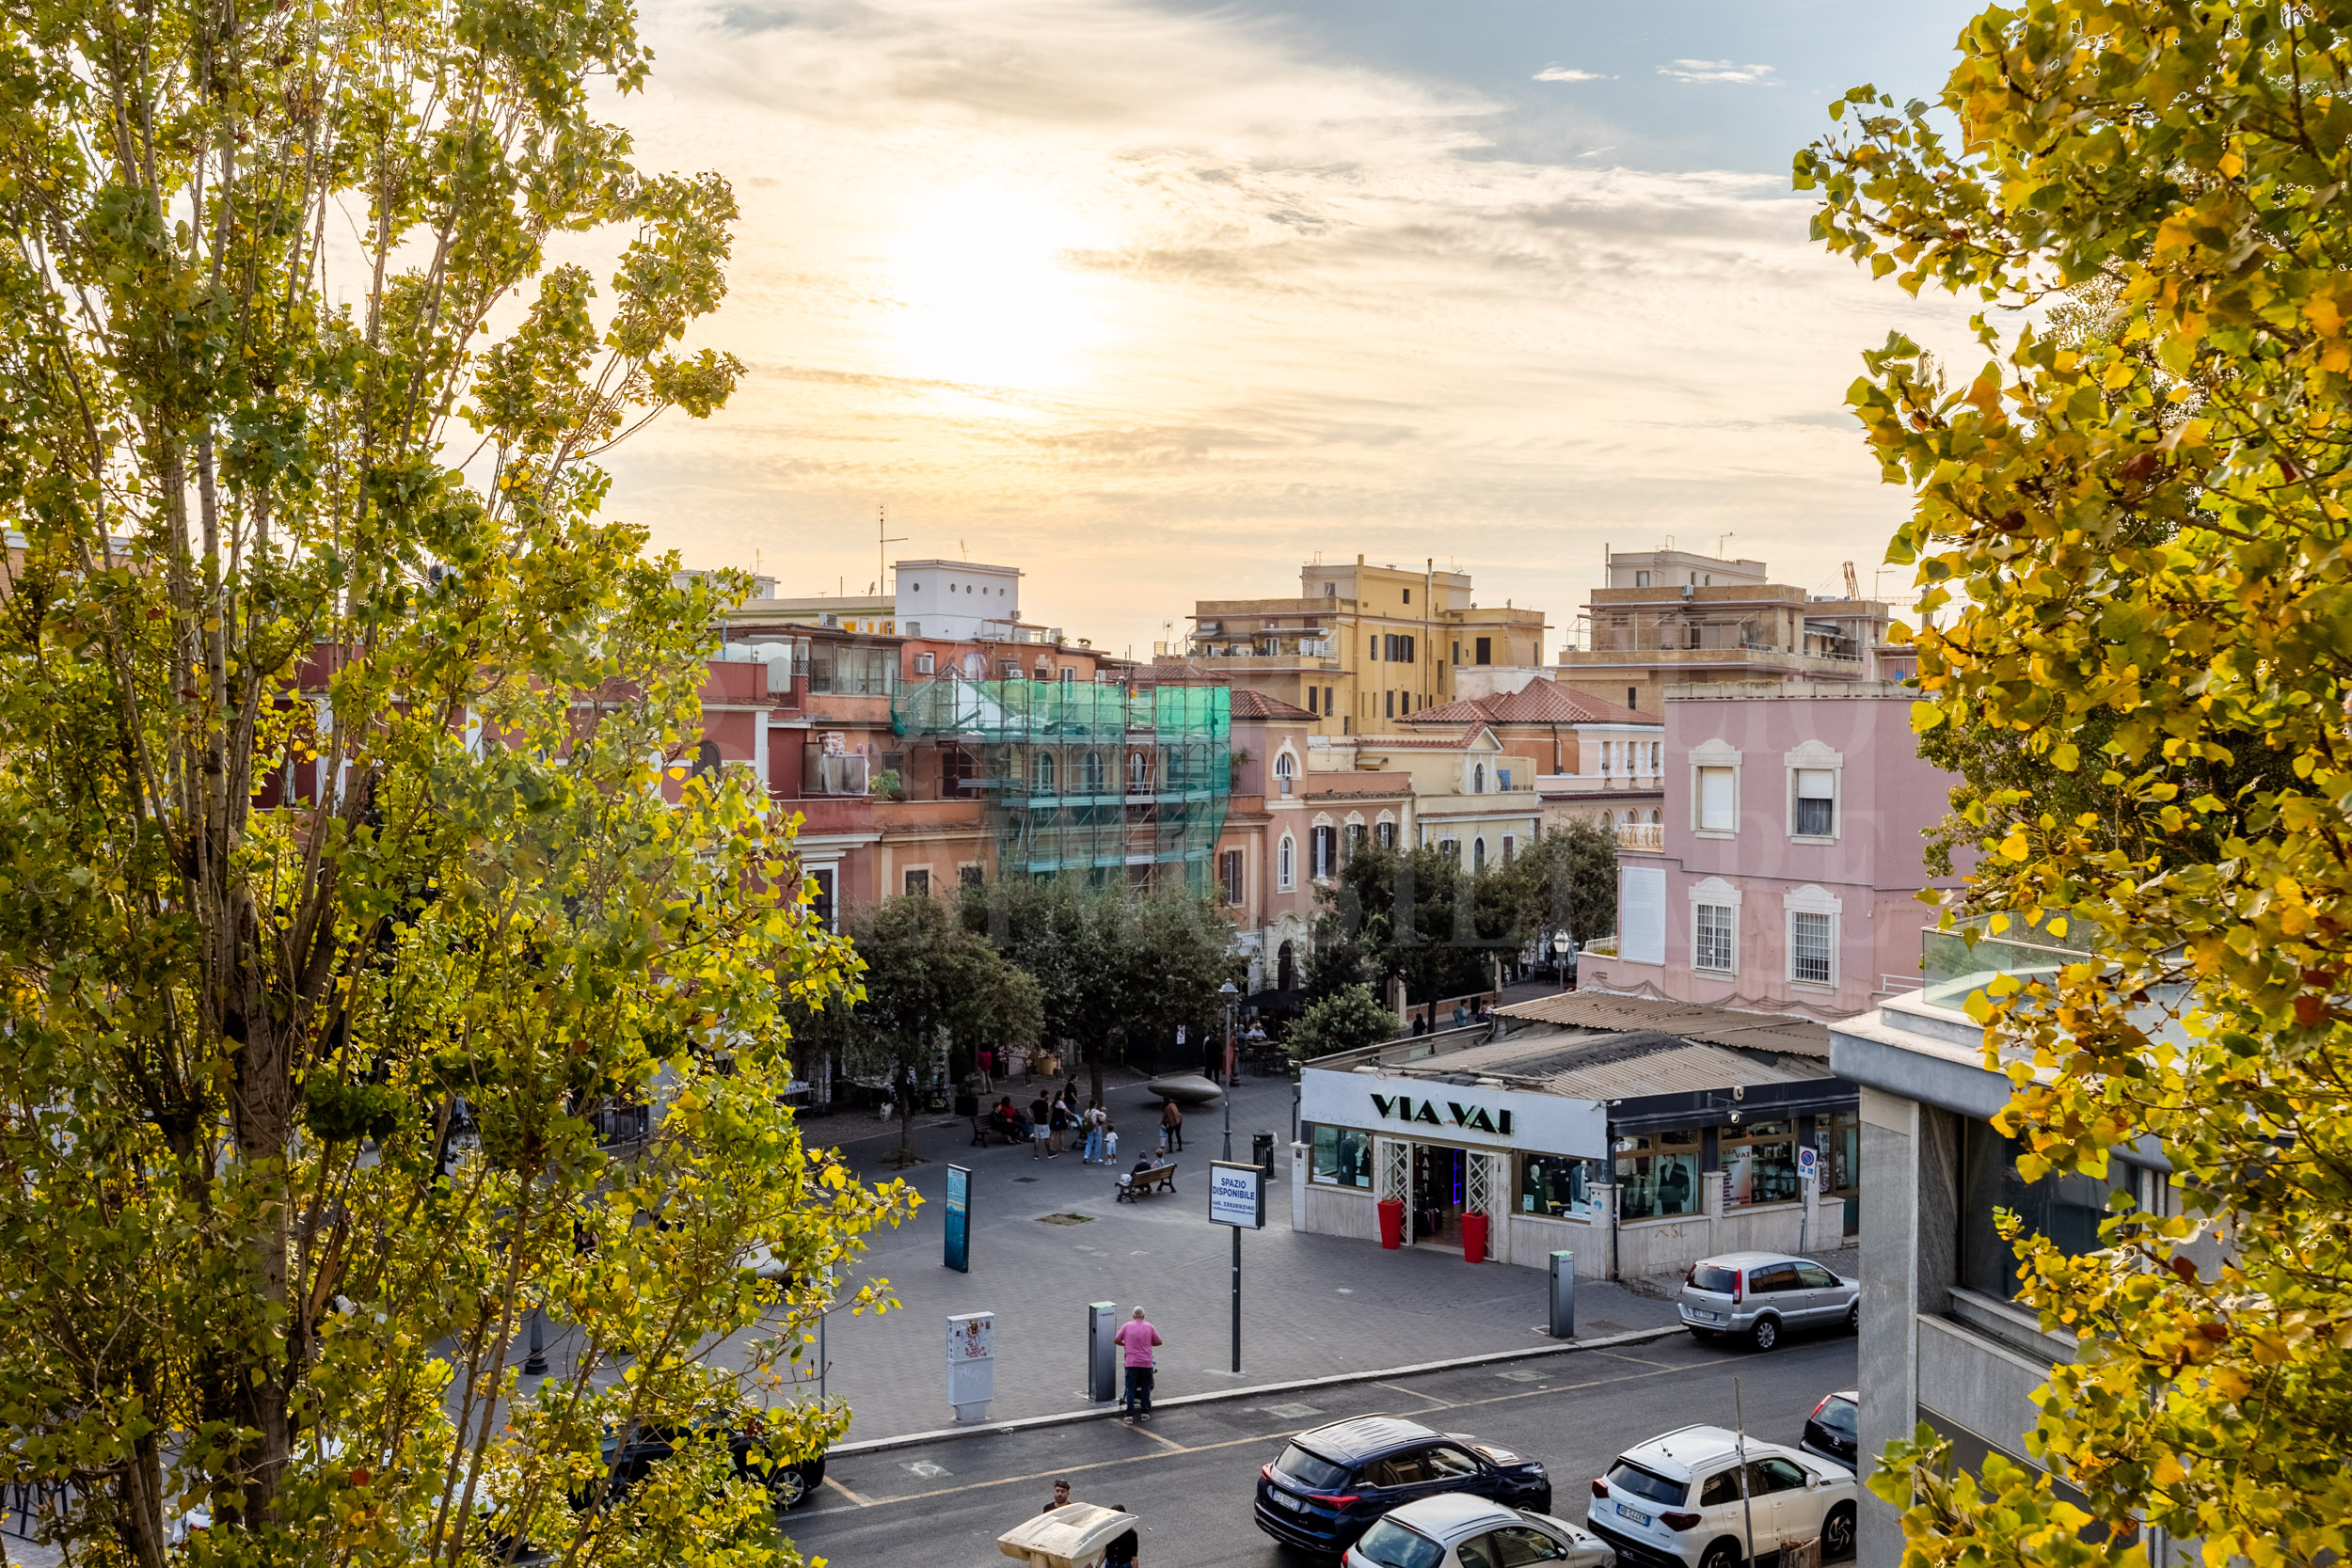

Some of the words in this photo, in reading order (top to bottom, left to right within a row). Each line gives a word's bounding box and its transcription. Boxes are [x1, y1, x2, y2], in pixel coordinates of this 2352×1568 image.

[1370, 1093, 1443, 1126] VIA
[1447, 1101, 1514, 1135] VAI
[1221, 1178, 1247, 1189] SPAZIO
[1213, 1186, 1255, 1200] DISPONIBILE
